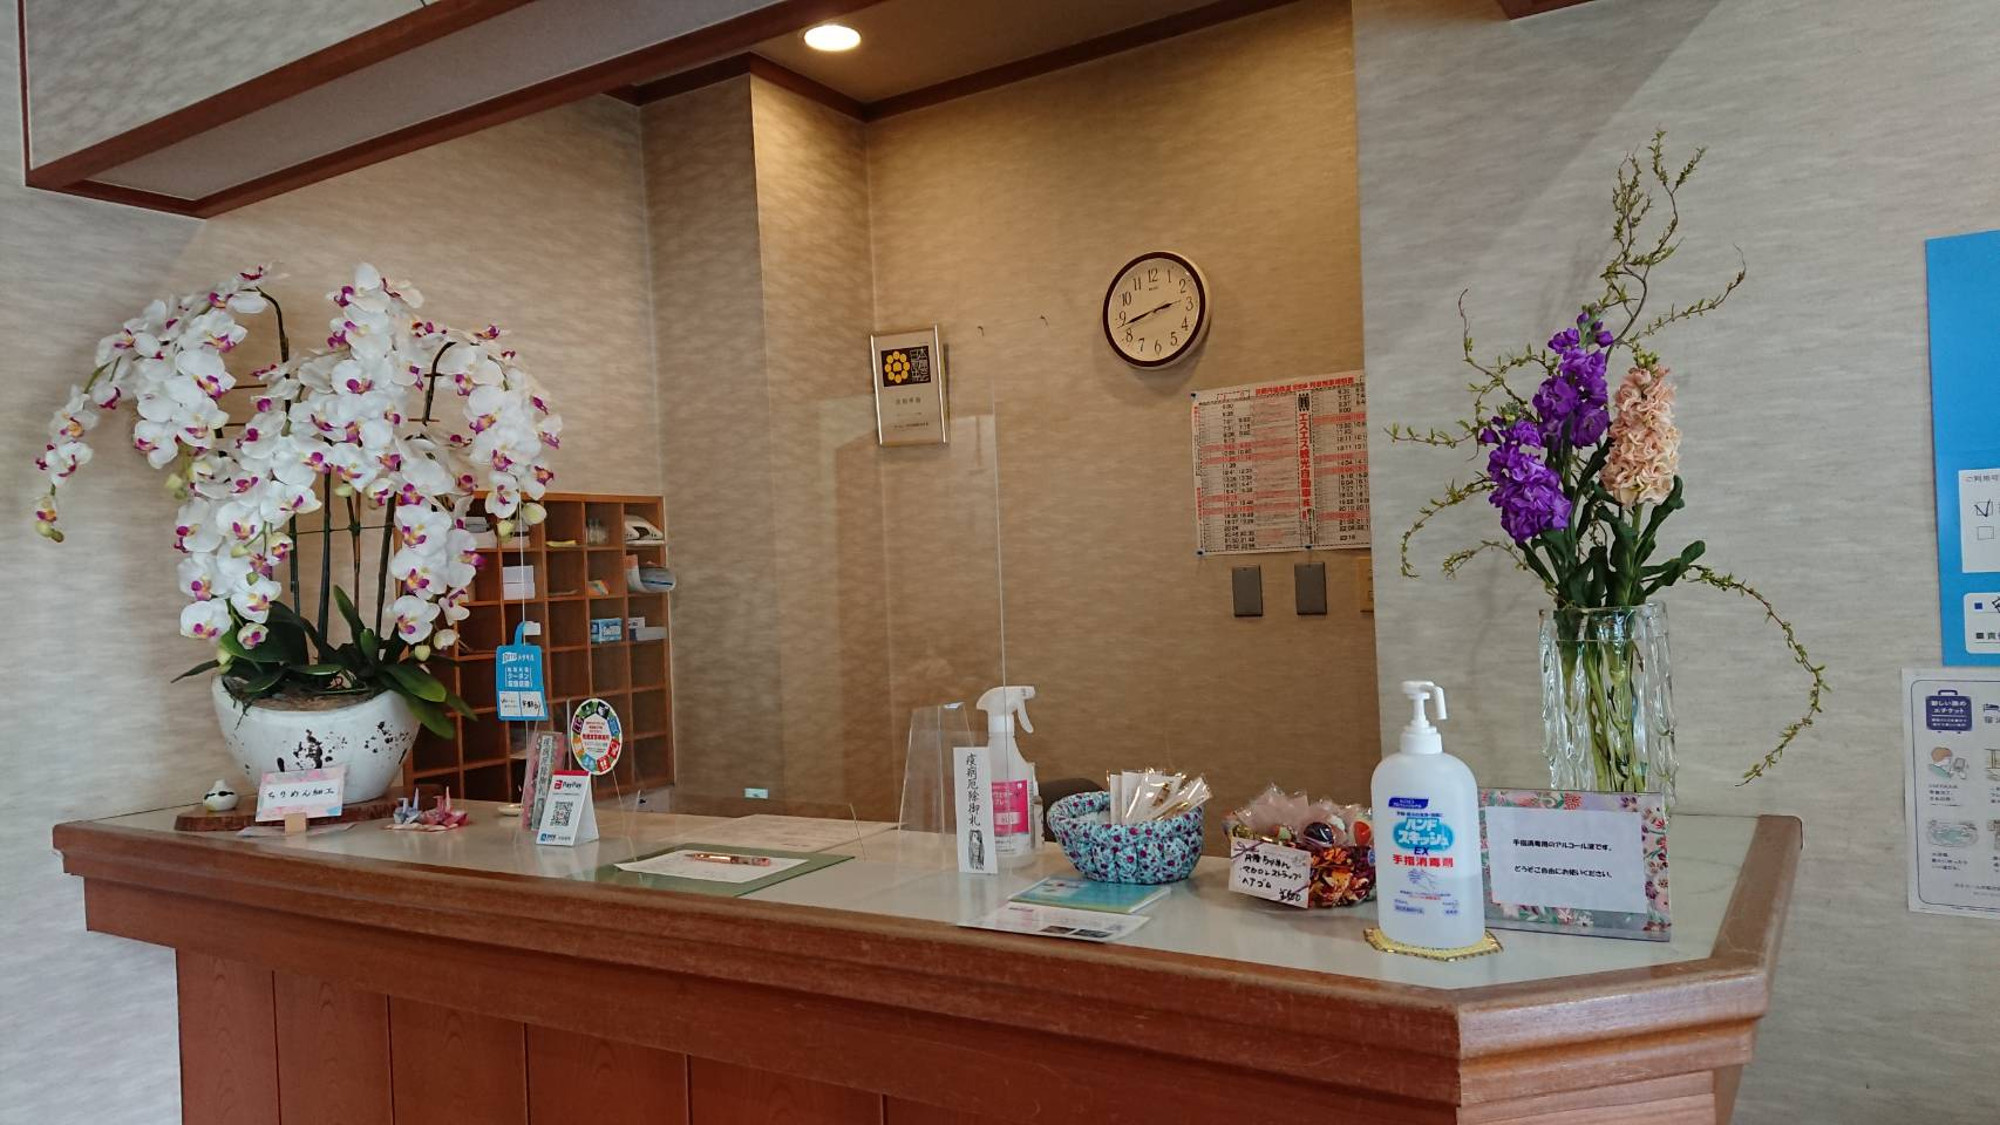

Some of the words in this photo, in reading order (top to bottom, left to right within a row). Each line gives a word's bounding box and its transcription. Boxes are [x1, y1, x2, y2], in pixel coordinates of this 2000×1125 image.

[1147, 268, 1158, 283] 12
[1166, 270, 1171, 283] 1
[1133, 277, 1142, 291] 11
[1179, 278, 1186, 293] 2
[1121, 292, 1132, 306] 10
[1185, 296, 1194, 311] 3
[1181, 315, 1188, 331] 4
[1125, 328, 1134, 342] 8
[1170, 331, 1178, 346] 5
[1138, 338, 1145, 352] 7
[1154, 339, 1162, 354] 6
[1414, 846, 1429, 856] EX
